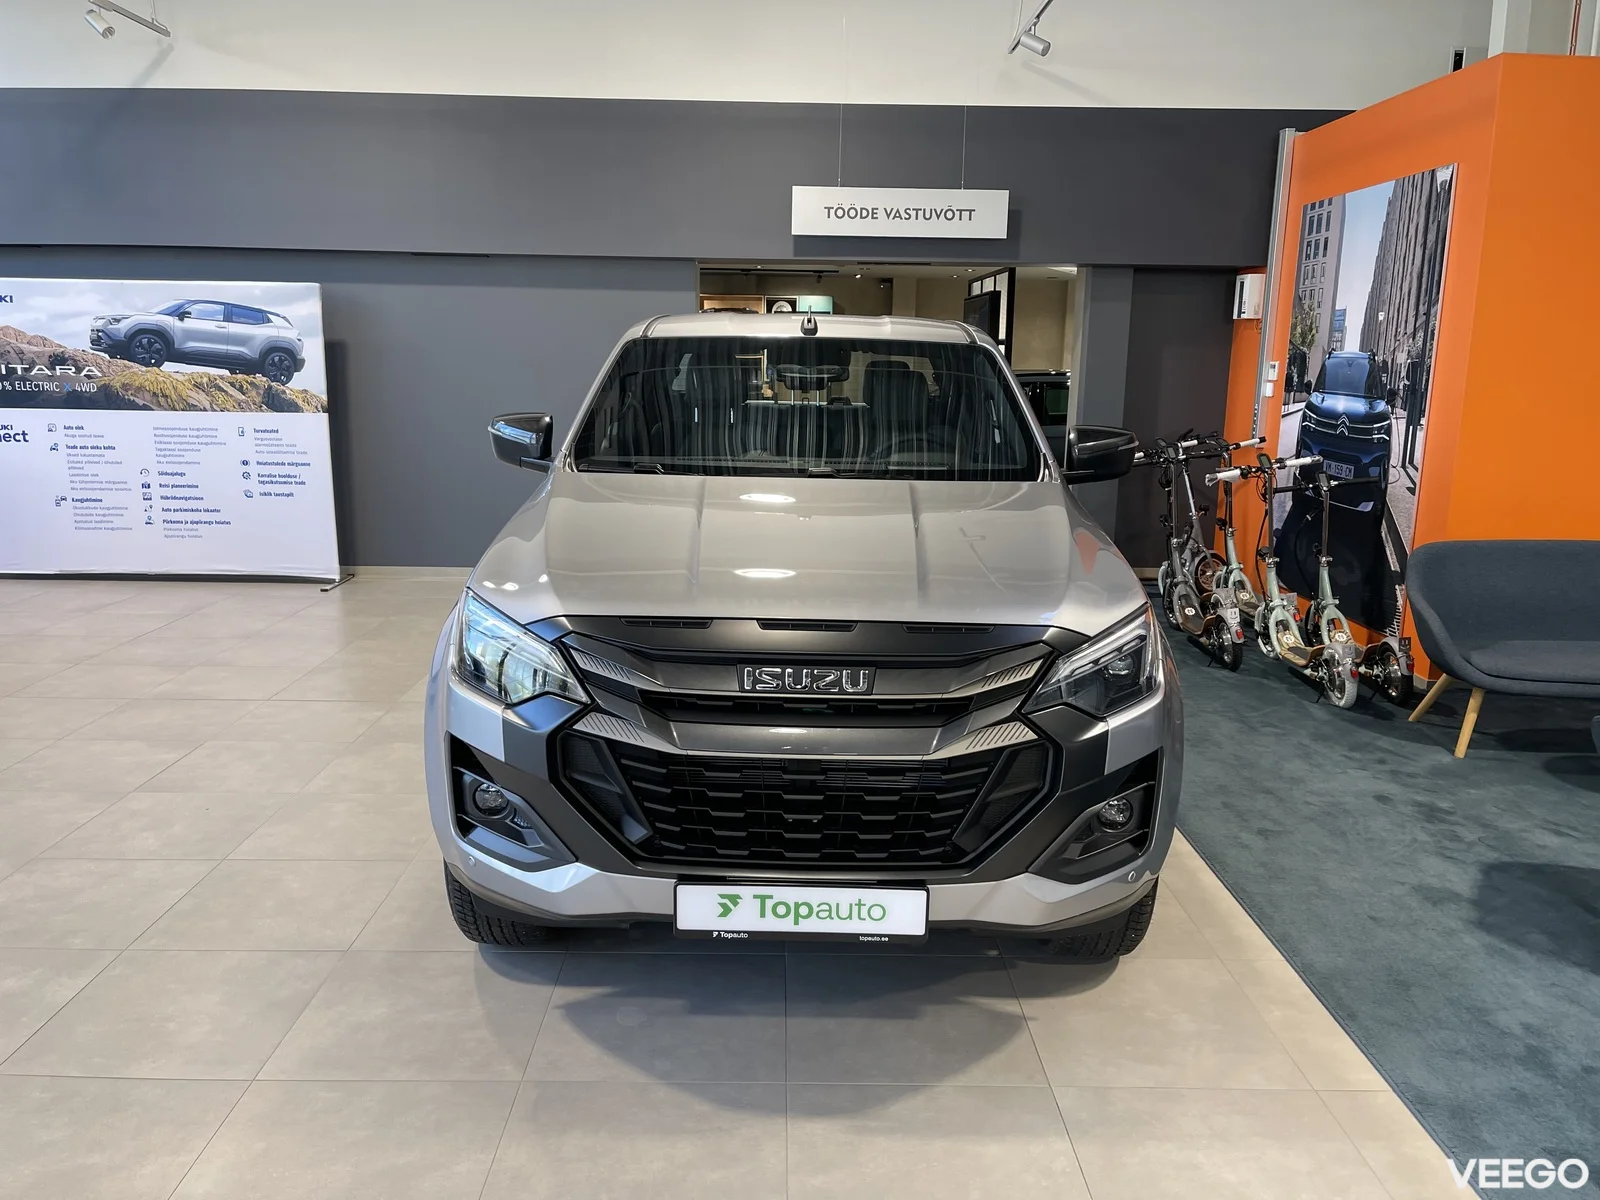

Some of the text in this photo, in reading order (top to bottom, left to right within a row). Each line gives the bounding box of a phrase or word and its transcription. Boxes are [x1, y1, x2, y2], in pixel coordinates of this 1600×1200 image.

[824, 203, 976, 222] TÖÖDE VASTUVÕTT
[1, 364, 102, 377] ITARA
[15, 382, 60, 392] ELECTRIC
[75, 382, 98, 392] 4WD
[744, 667, 869, 692] ISUZU
[753, 894, 887, 926] Topauto
[720, 932, 748, 940] Topauto
